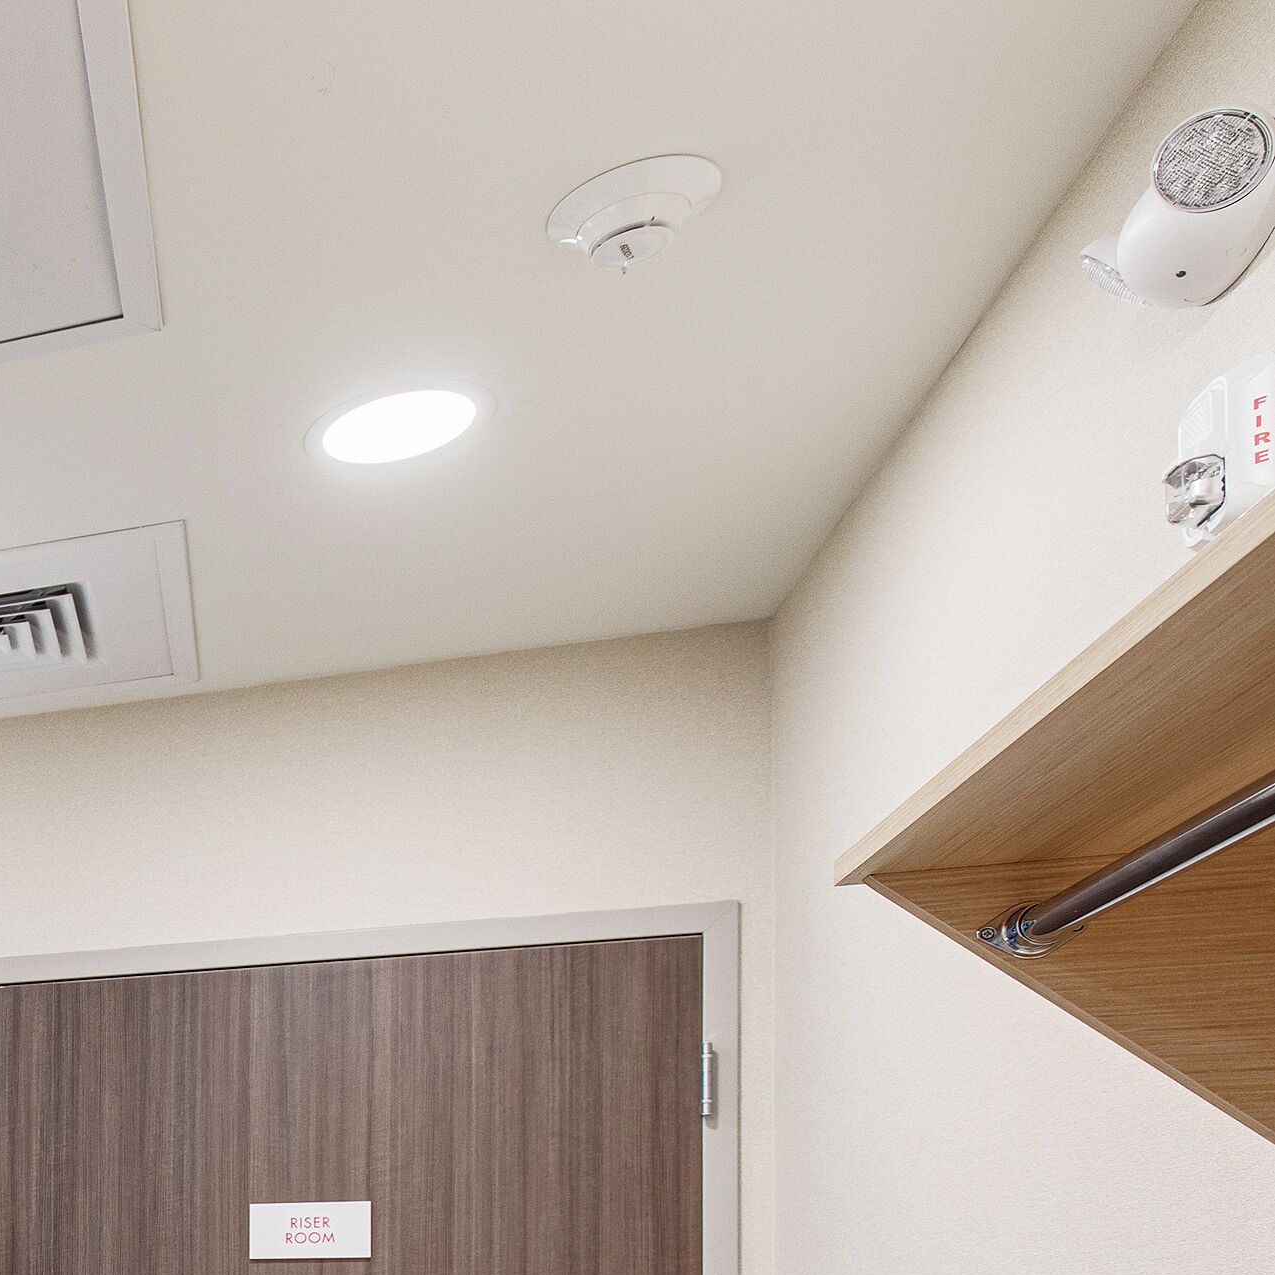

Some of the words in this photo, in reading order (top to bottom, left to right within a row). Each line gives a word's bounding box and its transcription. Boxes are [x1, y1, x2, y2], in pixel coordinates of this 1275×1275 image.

[1253, 395, 1271, 465] FIRE
[290, 1217, 331, 1229] RISER
[285, 1231, 336, 1244] ROOM
